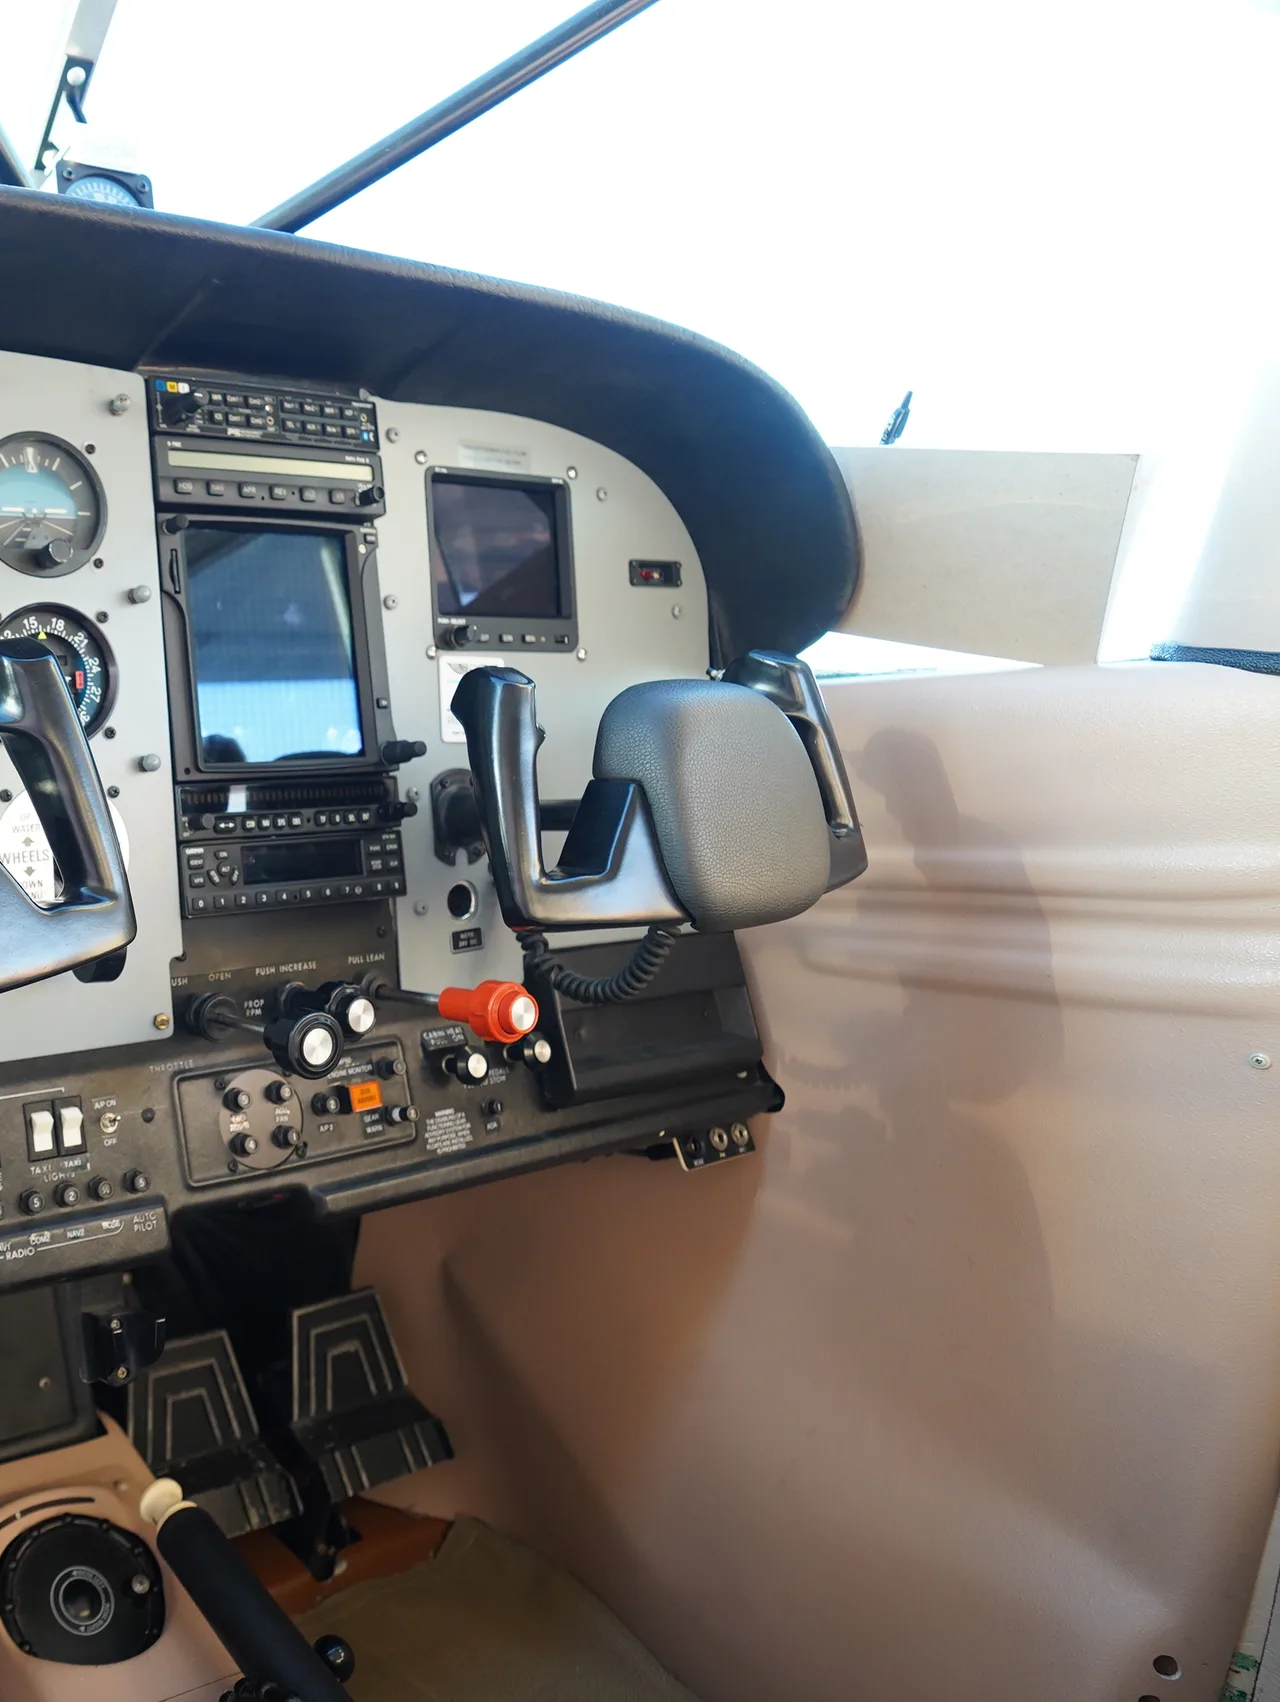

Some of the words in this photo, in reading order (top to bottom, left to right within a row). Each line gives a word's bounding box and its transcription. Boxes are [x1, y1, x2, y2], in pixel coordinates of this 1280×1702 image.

[23, 616, 38, 629] 15
[51, 617, 65, 631] 18
[74, 632, 88, 647] 21
[89, 657, 101, 673] 24
[91, 687, 102, 703] 27
[12, 824, 41, 834] WATER
[0, 849, 50, 864] WHEELS
[347, 955, 365, 965] PULL
[366, 953, 385, 963] LEAN
[255, 966, 276, 977] PUSH
[279, 960, 317, 974] INCREASE
[208, 972, 232, 982] OPEN
[148, 1059, 195, 1074] THROTTLE
[348, 1064, 373, 1076] MONITOR
[103, 1138, 117, 1148] OFF
[29, 1164, 52, 1176] TAXI
[64, 1158, 82, 1168] TAXI
[134, 1220, 158, 1232] PILOT
[67, 1228, 85, 1239] NAV2
[5, 1246, 36, 1261] RADIO
